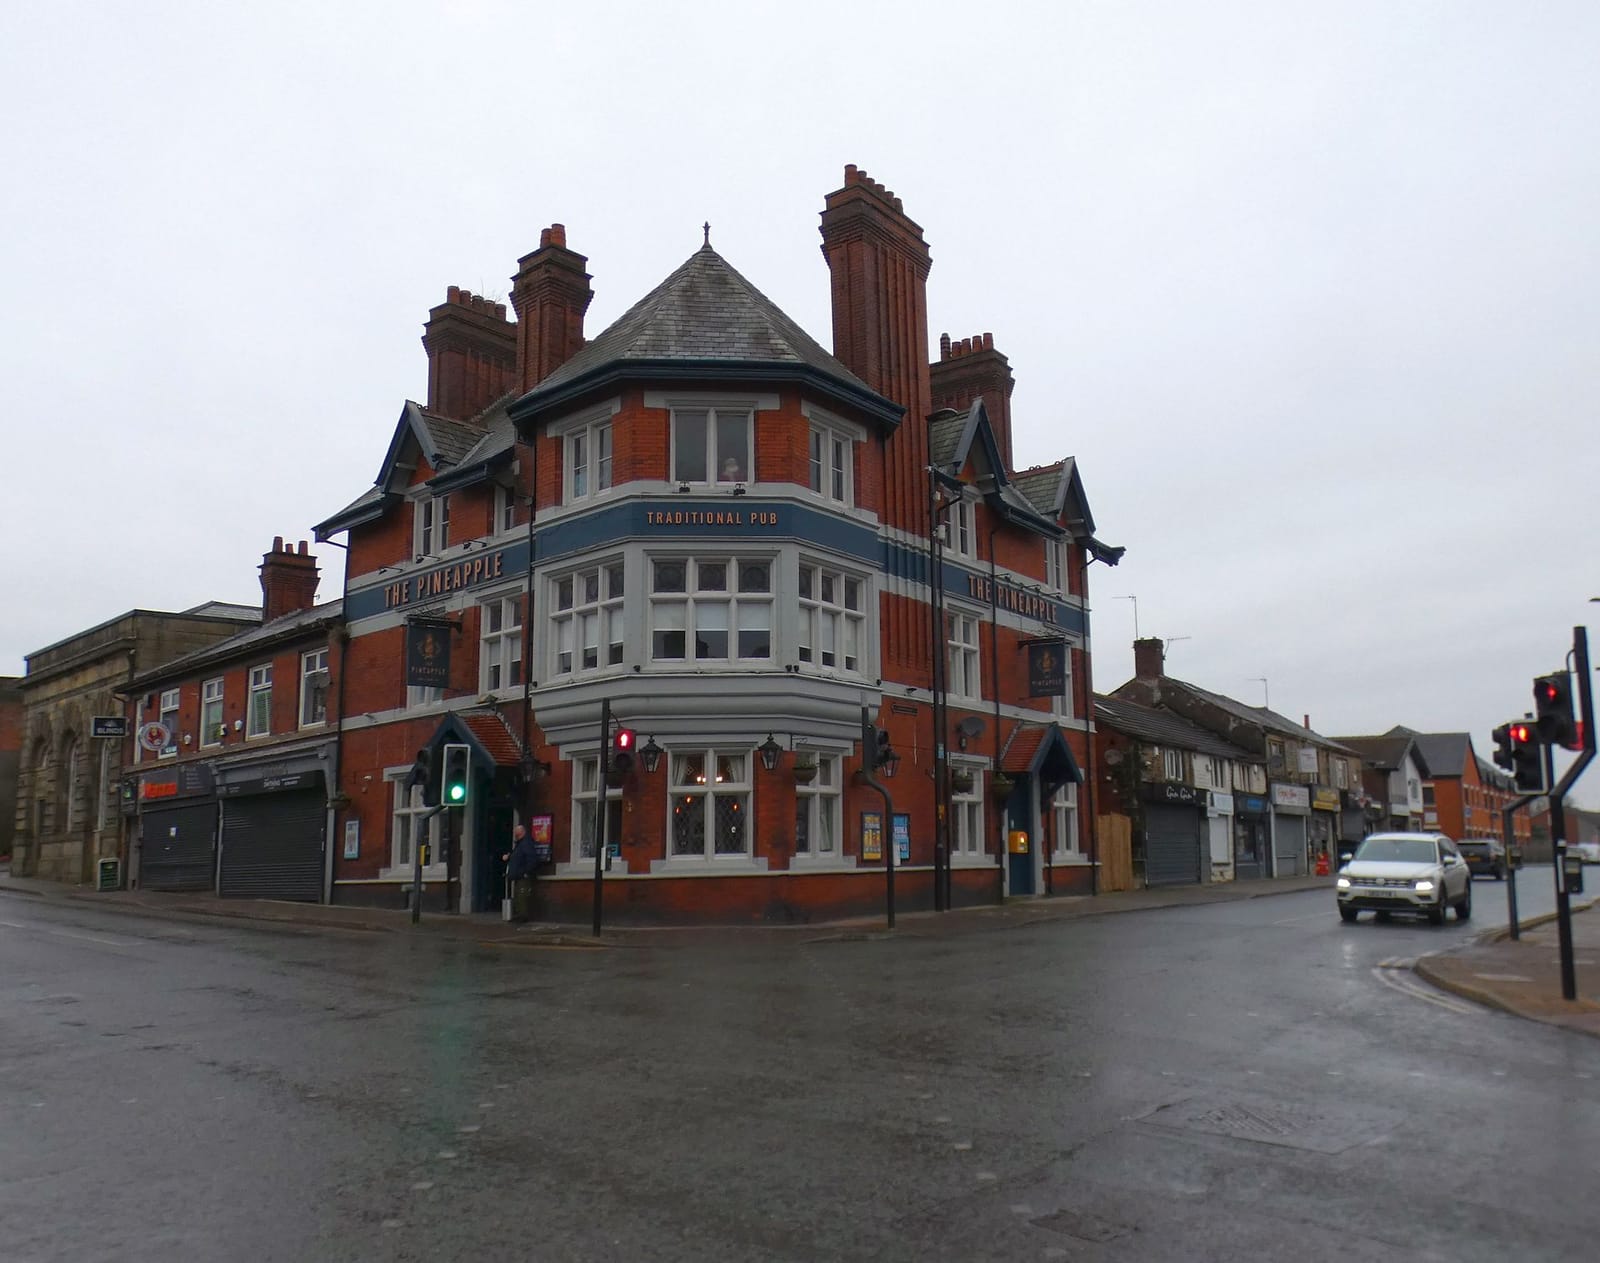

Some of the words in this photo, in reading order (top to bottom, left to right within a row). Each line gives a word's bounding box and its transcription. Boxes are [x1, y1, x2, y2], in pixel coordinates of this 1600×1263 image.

[647, 511, 742, 524] TRADITIONAL
[750, 512, 778, 524] PUB
[384, 580, 409, 608] THE
[416, 552, 503, 599] PINEAPPLE
[969, 575, 992, 601] THE
[997, 584, 1057, 624] PINEAPPLE
